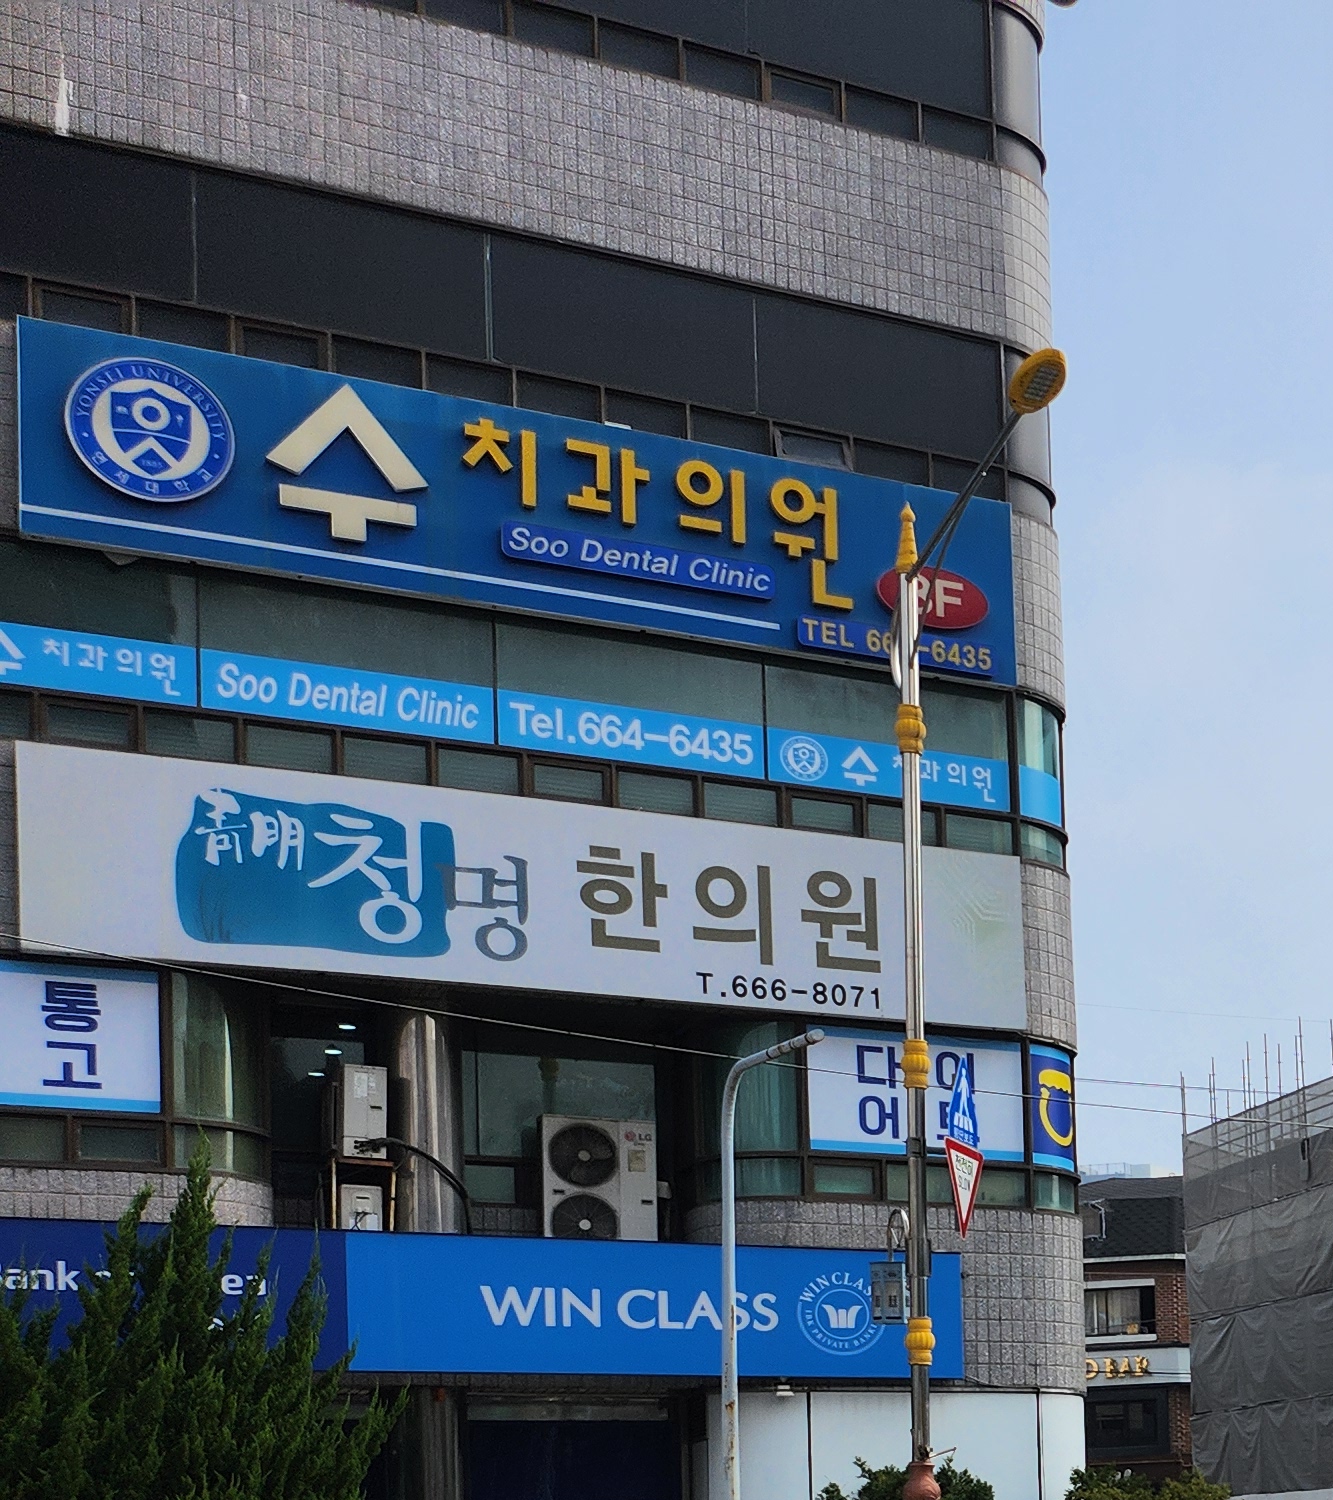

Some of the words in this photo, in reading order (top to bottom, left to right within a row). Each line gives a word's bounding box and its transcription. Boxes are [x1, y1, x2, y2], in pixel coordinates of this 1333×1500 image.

[76, 366, 124, 417] YONSEI
[131, 365, 226, 442] UNIVERSITY
[265, 383, 429, 542] 수
[462, 418, 854, 610] 치과의원
[509, 526, 570, 560] Soo
[580, 538, 679, 579] Dental
[688, 557, 772, 592] Clinic
[42, 637, 182, 697] 치과의원
[802, 617, 855, 648] TEL
[866, 629, 993, 671] 66-6435
[216, 663, 278, 704] Soo
[288, 673, 387, 718] Dental
[397, 687, 480, 730] Clinic
[510, 702, 754, 766] Tel.664-6435
[576, 845, 882, 973] 한의원
[696, 971, 882, 1010] T.666-8071
[43, 1041, 102, 1089] 고
[638, 1133, 652, 1141] LG
[0, 1260, 81, 1291] ank
[800, 1274, 831, 1303] WIN
[480, 1285, 601, 1328] WIN
[616, 1289, 780, 1332] CLASS
[811, 1328, 849, 1349] PRIVATE
